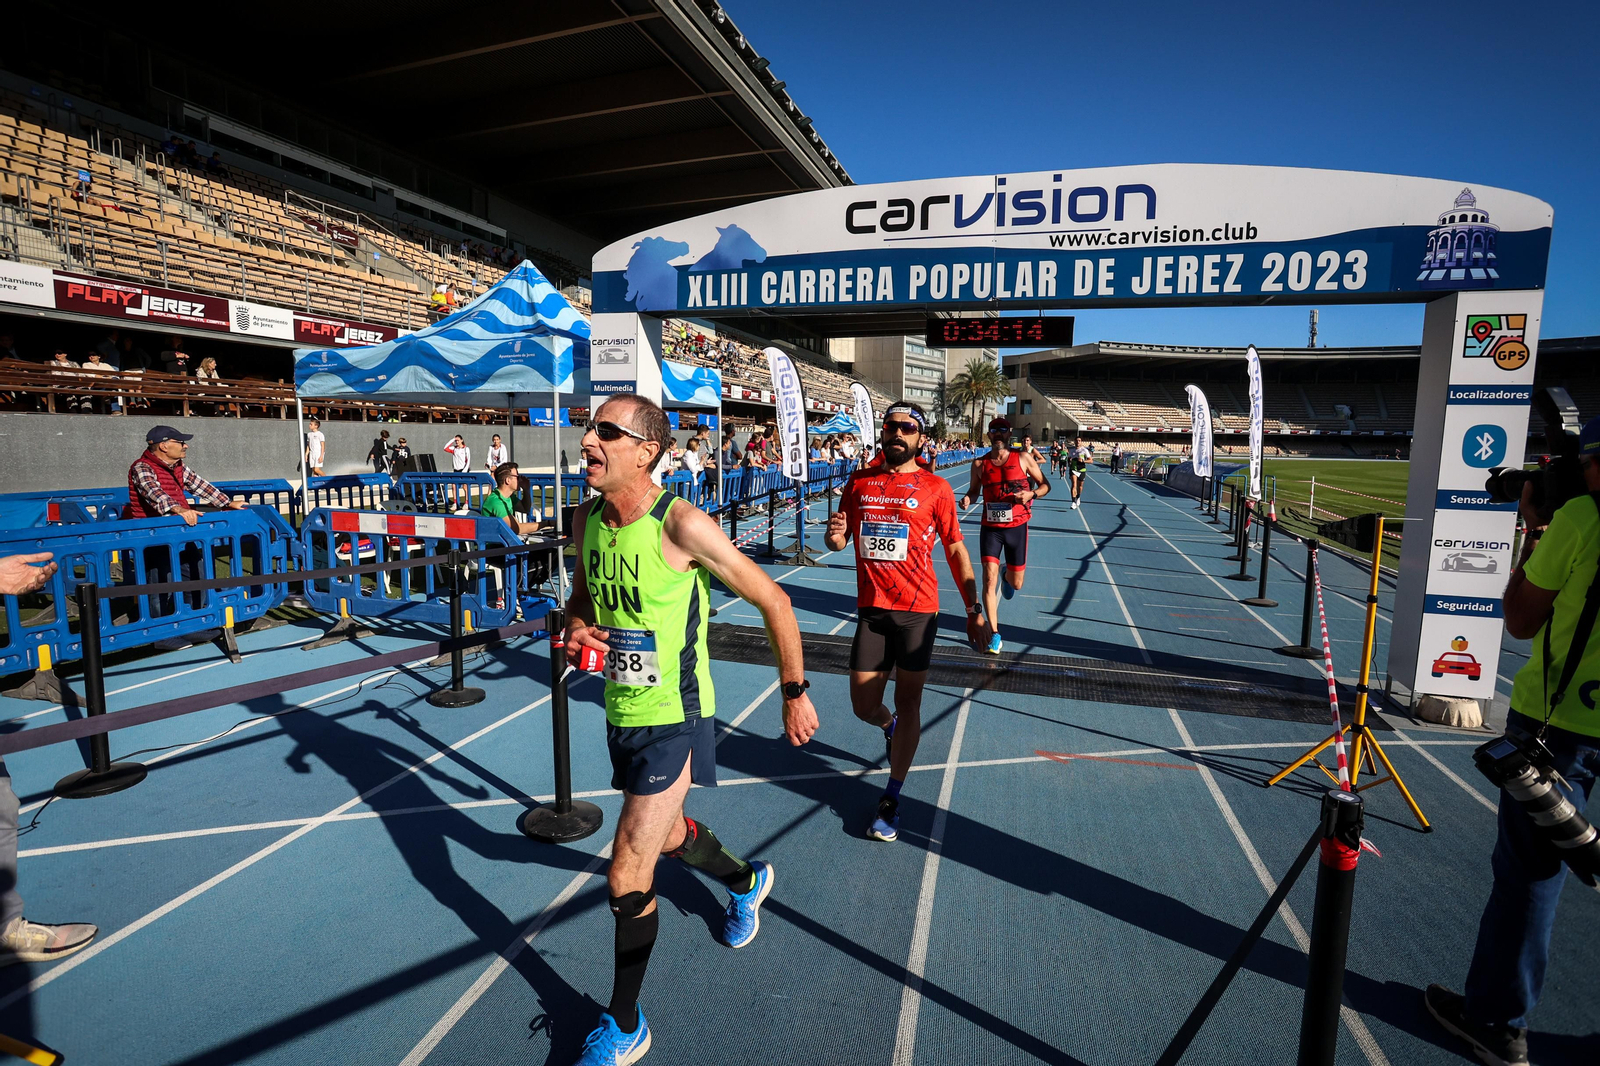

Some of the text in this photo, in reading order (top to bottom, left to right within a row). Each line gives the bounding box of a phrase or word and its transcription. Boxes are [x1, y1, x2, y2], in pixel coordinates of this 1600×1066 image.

[845, 173, 1157, 235] carvision
[1049, 221, 1259, 248] www.carvision.club
[687, 249, 1369, 308] XLIII CARRERA POPULAR DE JEREZ 2023
[67, 283, 136, 306] PLAY
[252, 315, 289, 325] Ayuntamiento
[260, 321, 274, 329] Jerez
[301, 321, 341, 337] PLAY
[943, 319, 1044, 342] 0:34:14
[592, 338, 635, 346] carvision
[1497, 350, 1526, 361] GPS
[593, 384, 634, 392] Multimedia
[1449, 390, 1530, 400] Localizadores
[860, 494, 905, 505] Movijerez
[992, 510, 1006, 518] 808
[868, 537, 896, 552] 386
[1434, 539, 1510, 550] carvision
[589, 549, 638, 582] RUN
[589, 581, 642, 613] RUN
[1437, 600, 1493, 612] Seguridad
[608, 650, 643, 672] 958
